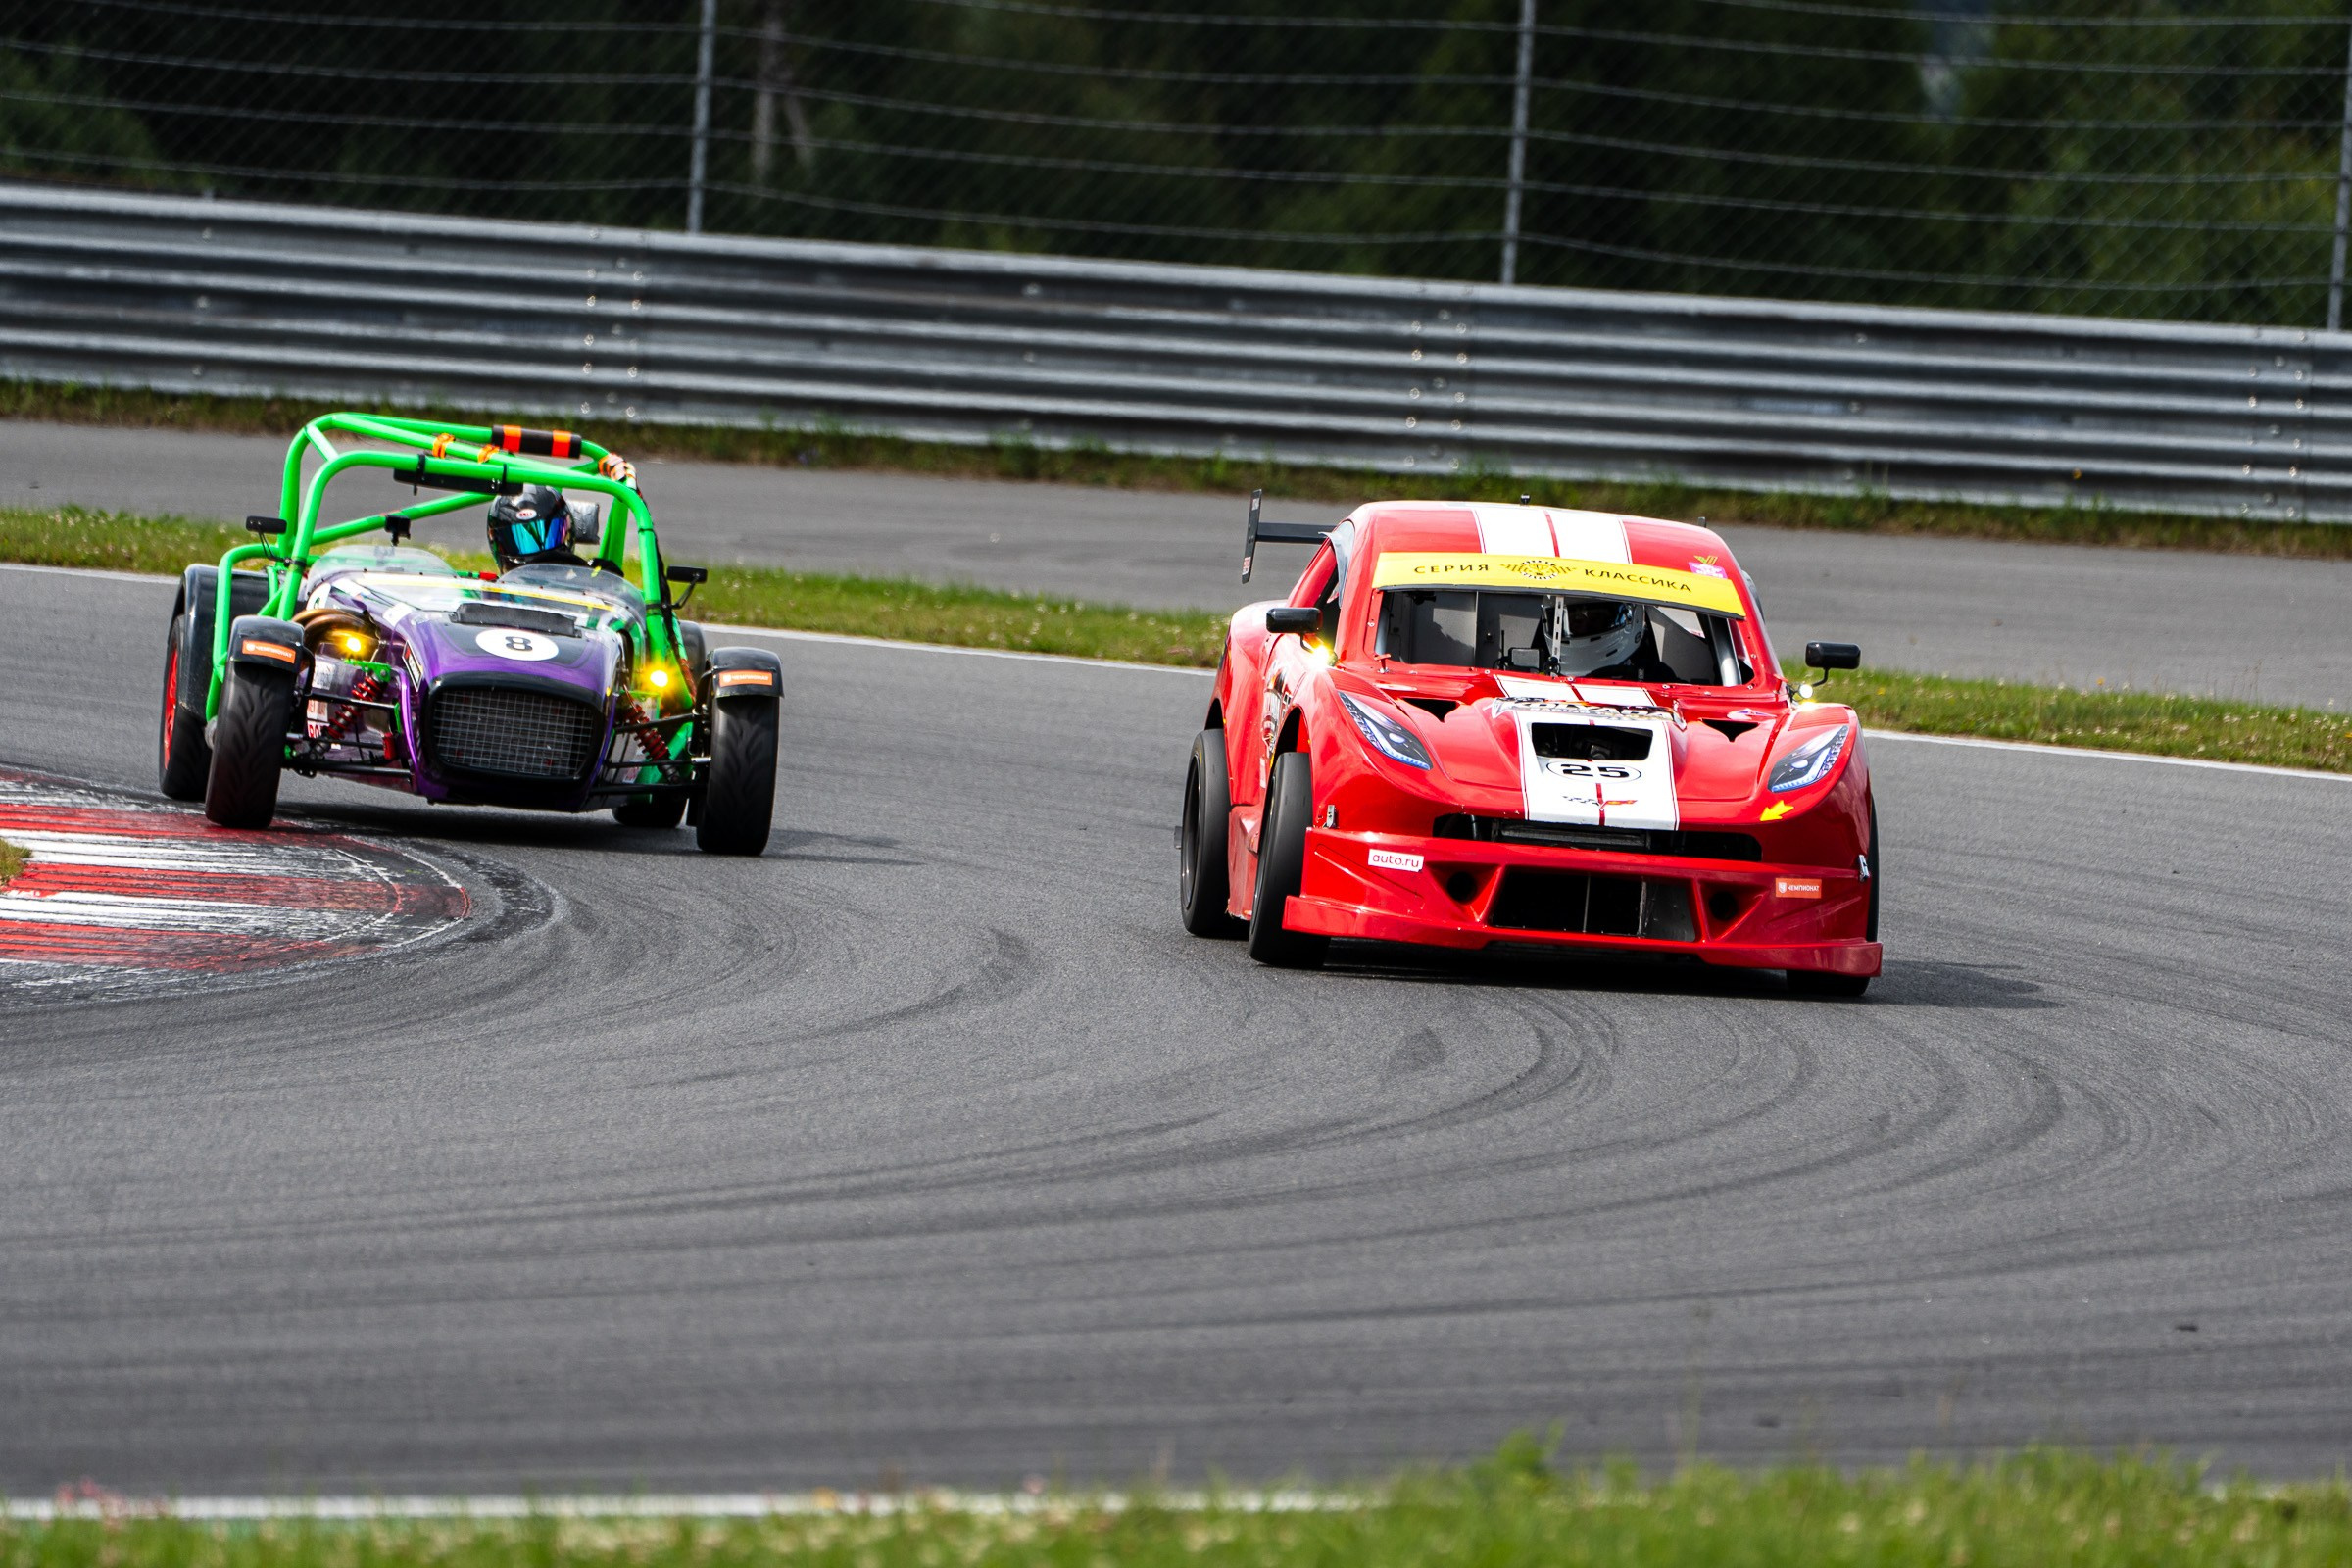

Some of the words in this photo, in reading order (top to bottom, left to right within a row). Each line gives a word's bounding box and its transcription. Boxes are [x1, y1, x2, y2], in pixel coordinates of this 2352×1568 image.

[1414, 564, 1490, 574] СЕРИЯ
[1584, 568, 1692, 592] КЛАССИКА
[504, 635, 533, 652] 8
[1560, 763, 1630, 778] 25
[1372, 854, 1419, 868] auto.ru
